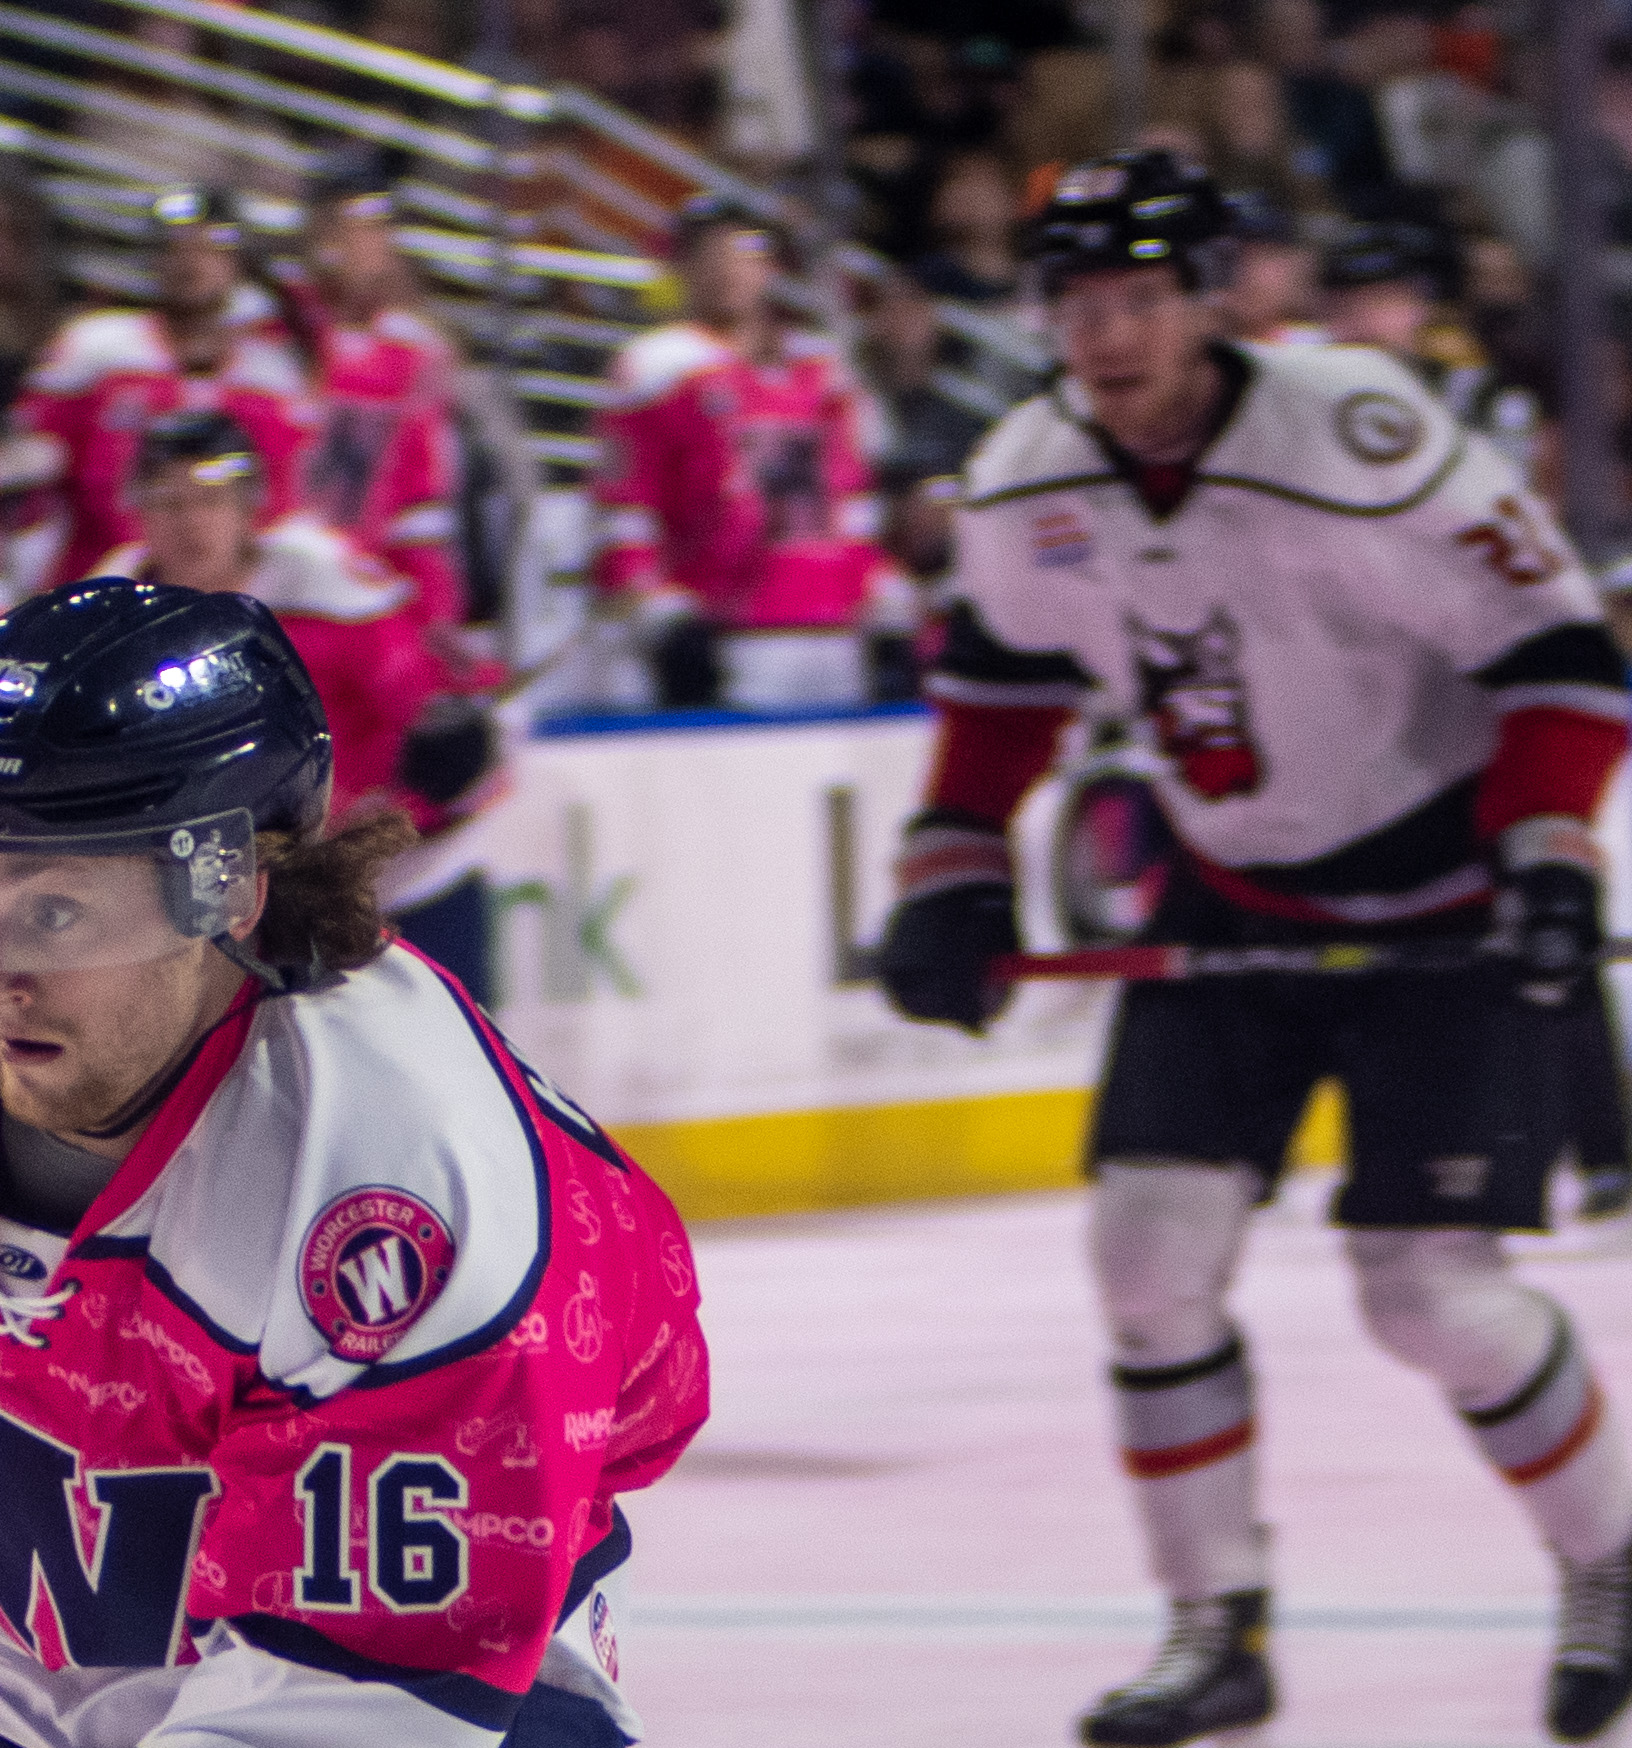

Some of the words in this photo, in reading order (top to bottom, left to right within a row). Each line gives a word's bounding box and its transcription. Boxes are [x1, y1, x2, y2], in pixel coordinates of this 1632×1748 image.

[311, 1198, 416, 1272] WORCESTER
[338, 1235, 411, 1325] W
[294, 1441, 470, 1613] 16
